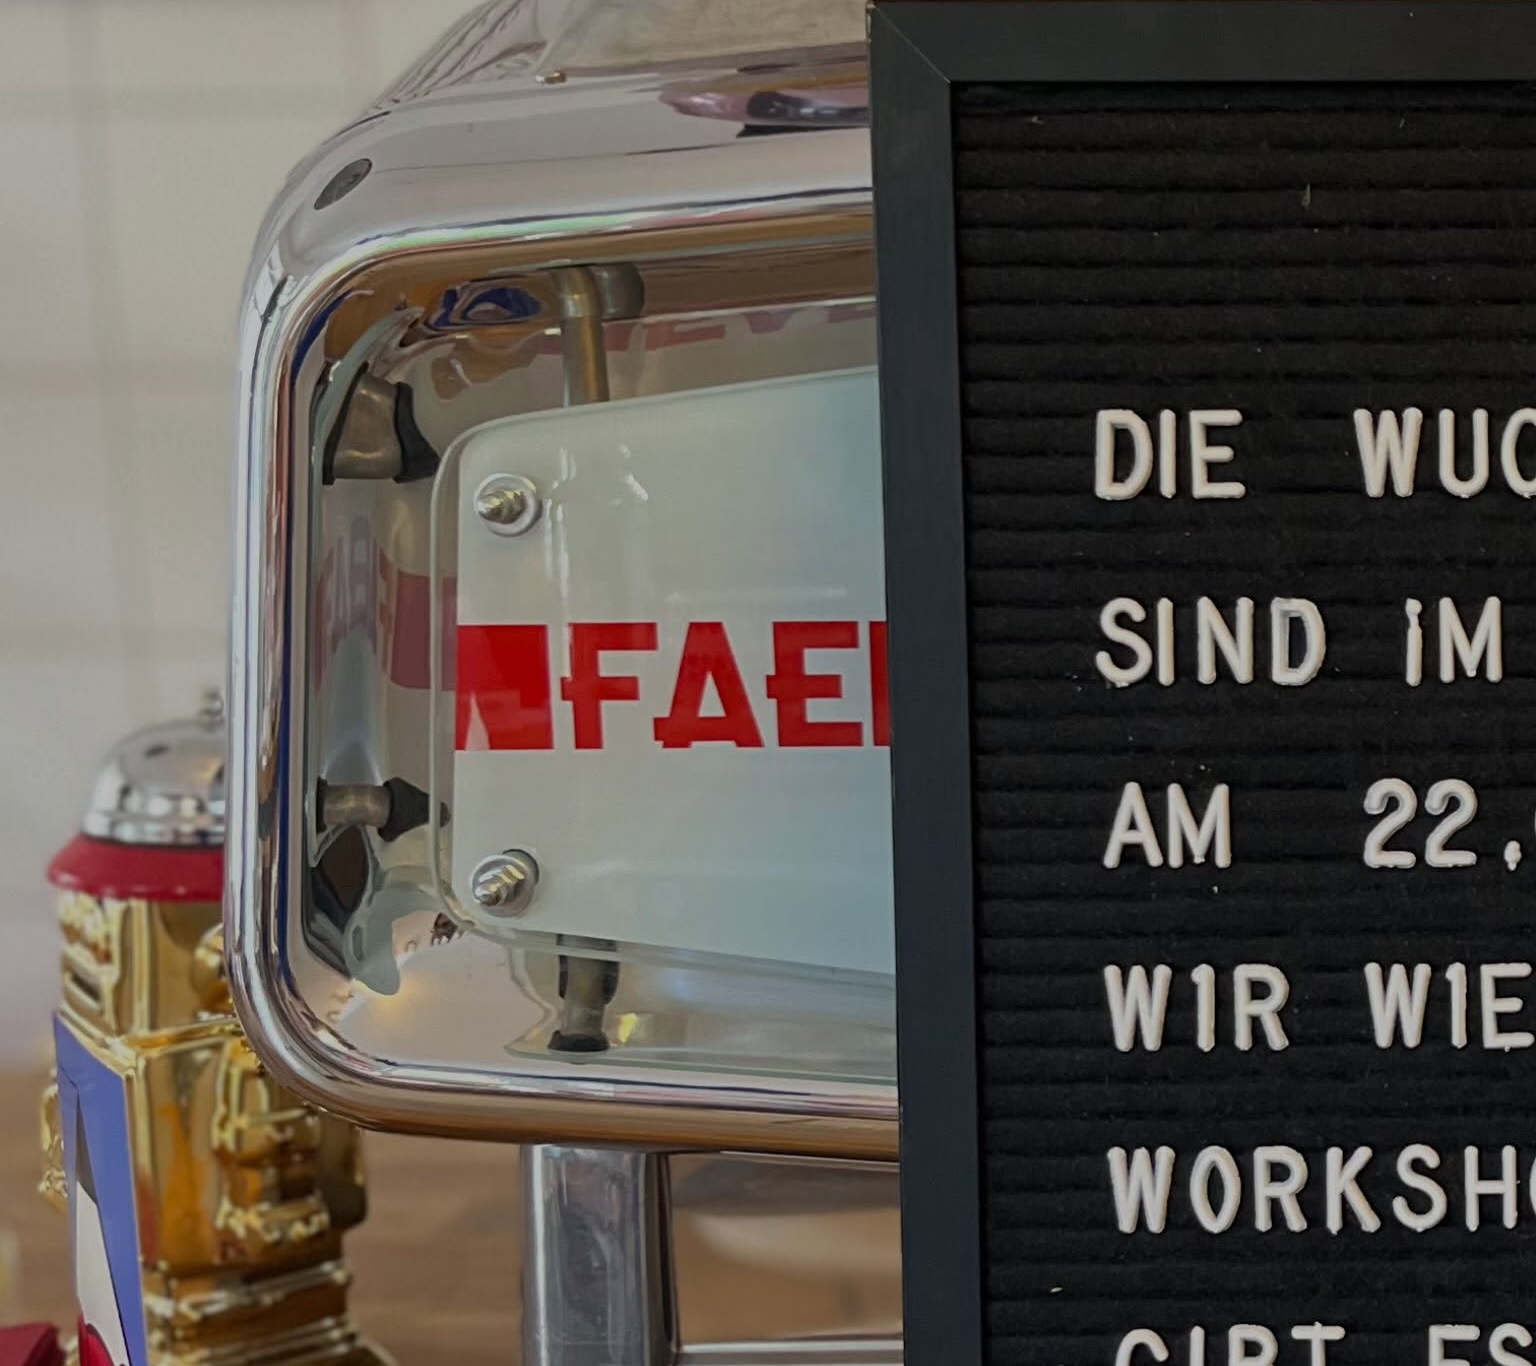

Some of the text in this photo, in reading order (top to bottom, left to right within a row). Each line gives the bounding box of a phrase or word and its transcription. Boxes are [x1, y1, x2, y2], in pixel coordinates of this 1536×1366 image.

[1094, 407, 1246, 501] DIE
[560, 621, 890, 749] FAE
[1095, 595, 1328, 688] SIND
[1102, 780, 1233, 869] AM
[1102, 962, 1291, 1053] WIR
